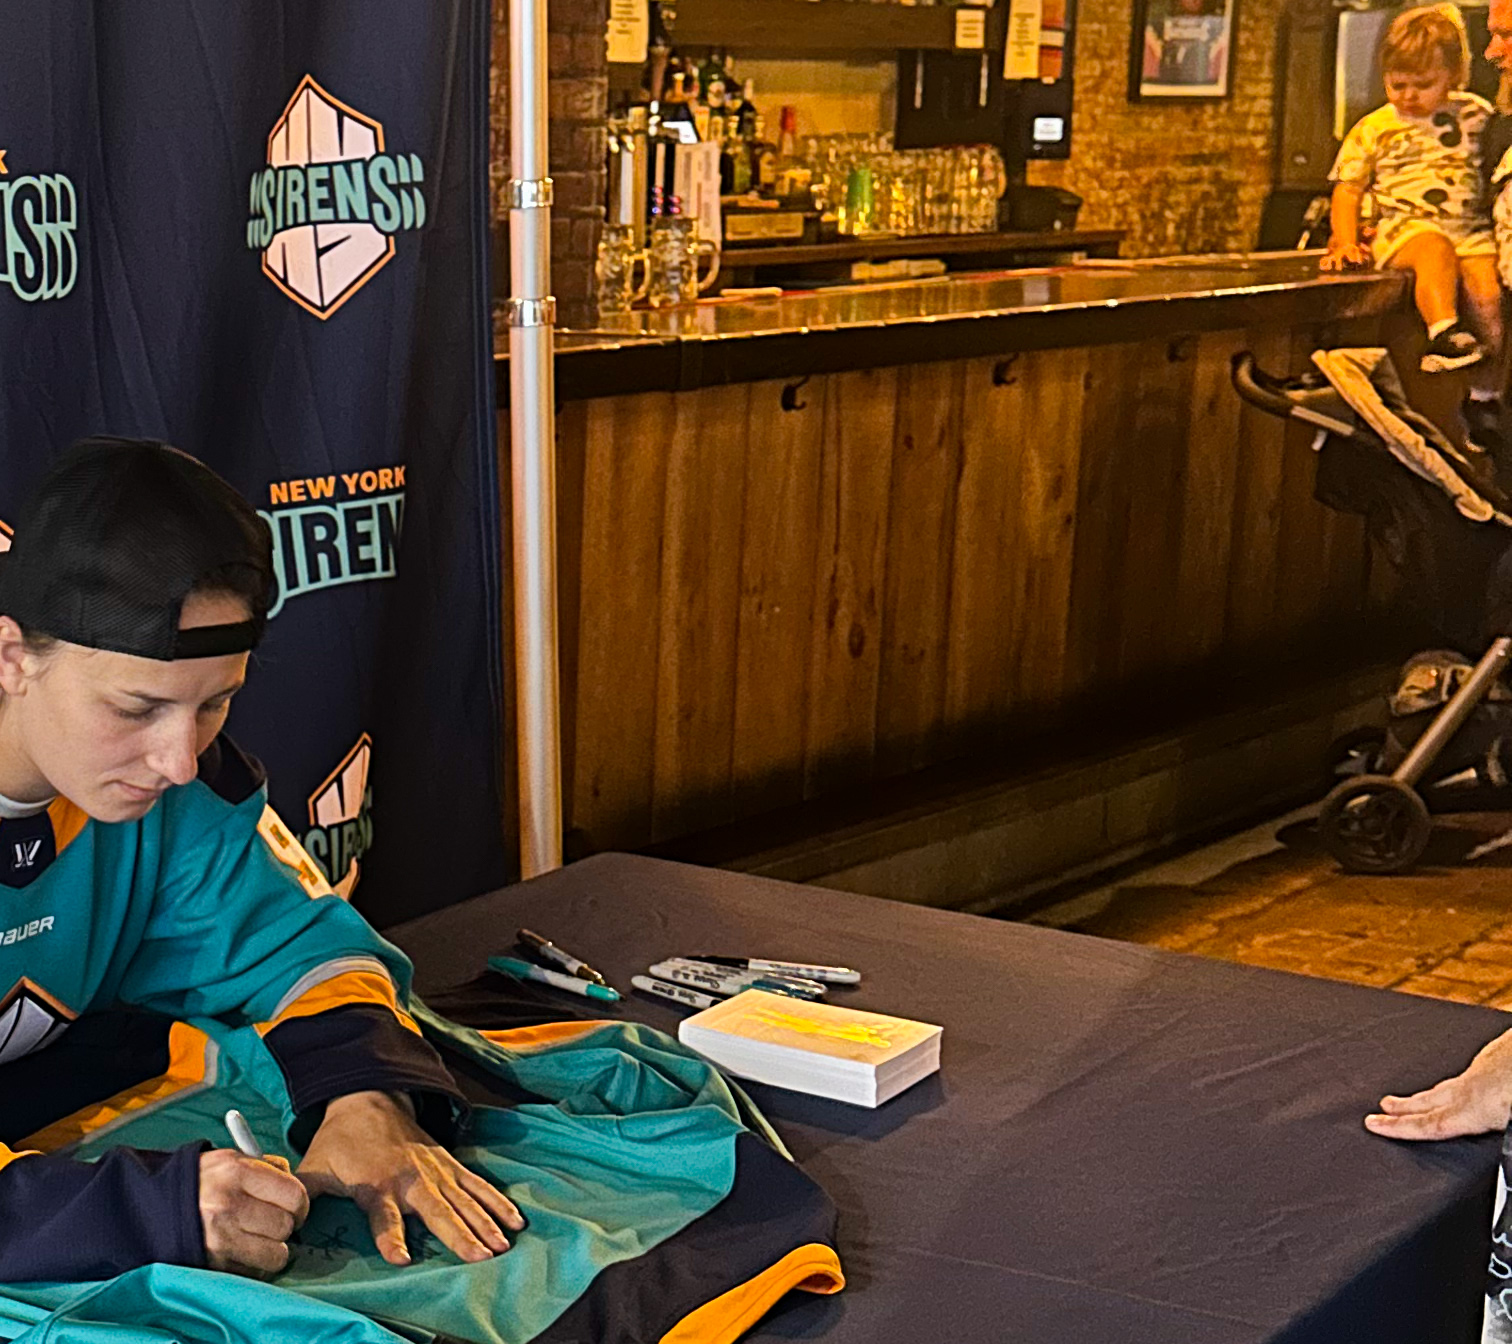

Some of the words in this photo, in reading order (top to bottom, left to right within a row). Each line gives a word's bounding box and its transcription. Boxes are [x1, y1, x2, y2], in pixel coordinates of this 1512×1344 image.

[258, 155, 402, 248] SIRENS
[270, 475, 336, 504] NEW
[341, 465, 406, 495] YORK
[264, 493, 405, 611] IREN
